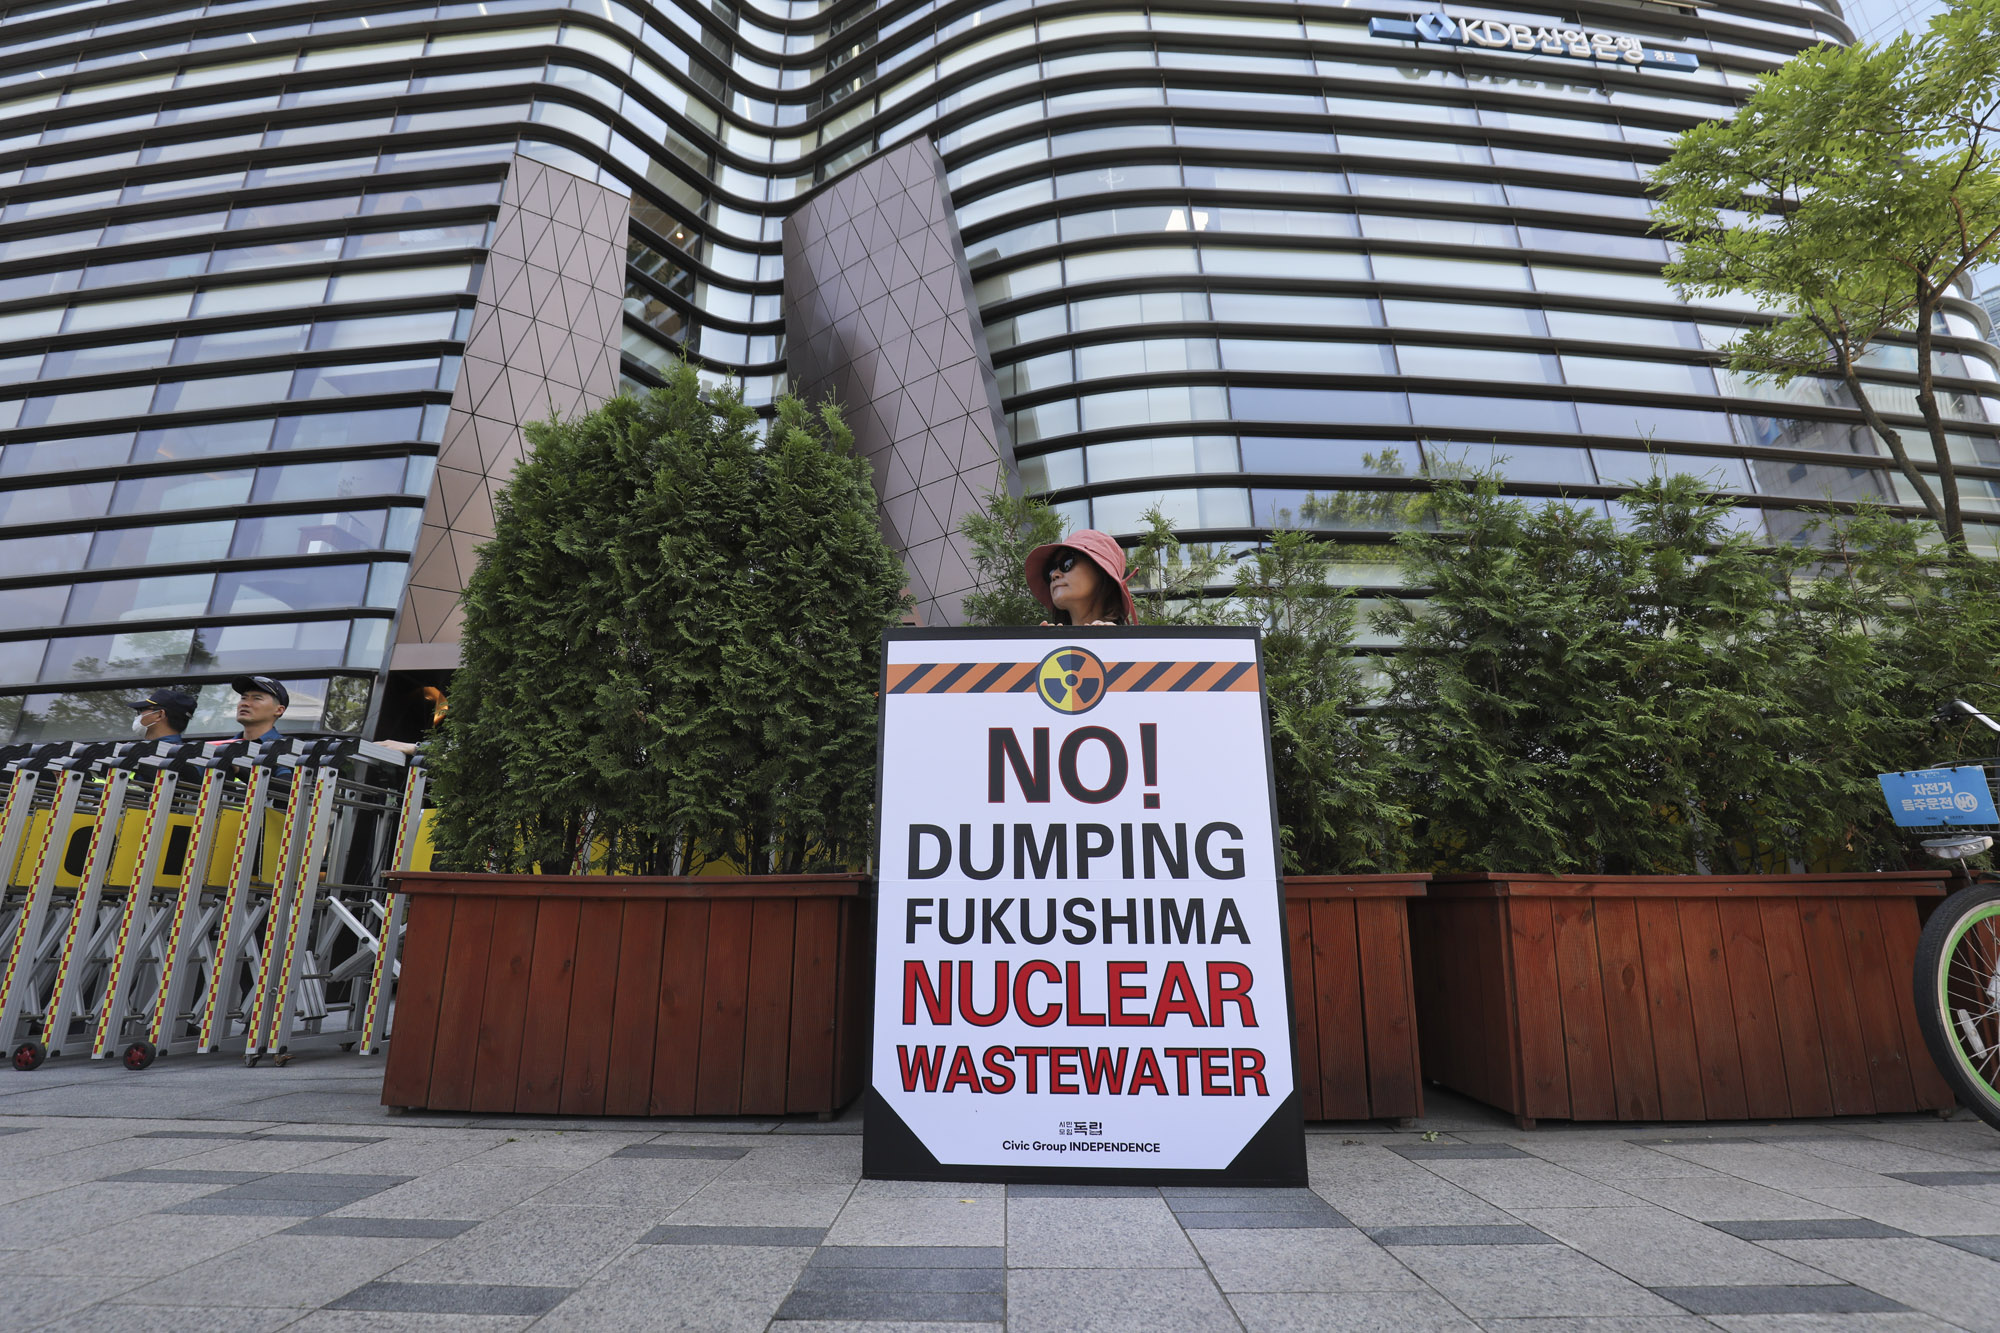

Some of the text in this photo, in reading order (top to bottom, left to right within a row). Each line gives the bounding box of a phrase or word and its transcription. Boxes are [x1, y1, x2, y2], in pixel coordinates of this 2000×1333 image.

[1459, 18, 1645, 64] KDB산업은행
[988, 723, 1160, 809] NO!
[1911, 781, 1953, 796] 자전거
[1901, 797, 1954, 811] 음주운전
[908, 822, 1245, 879] DUMPING
[906, 898, 1251, 945] FUKUSHIMA
[902, 959, 1259, 1027] NUCLEAR
[896, 1045, 1270, 1096] WASTEWATER
[1003, 1140, 1160, 1153] Civic Group INDEPENDENCE
[1073, 1121, 1103, 1136] 독립
